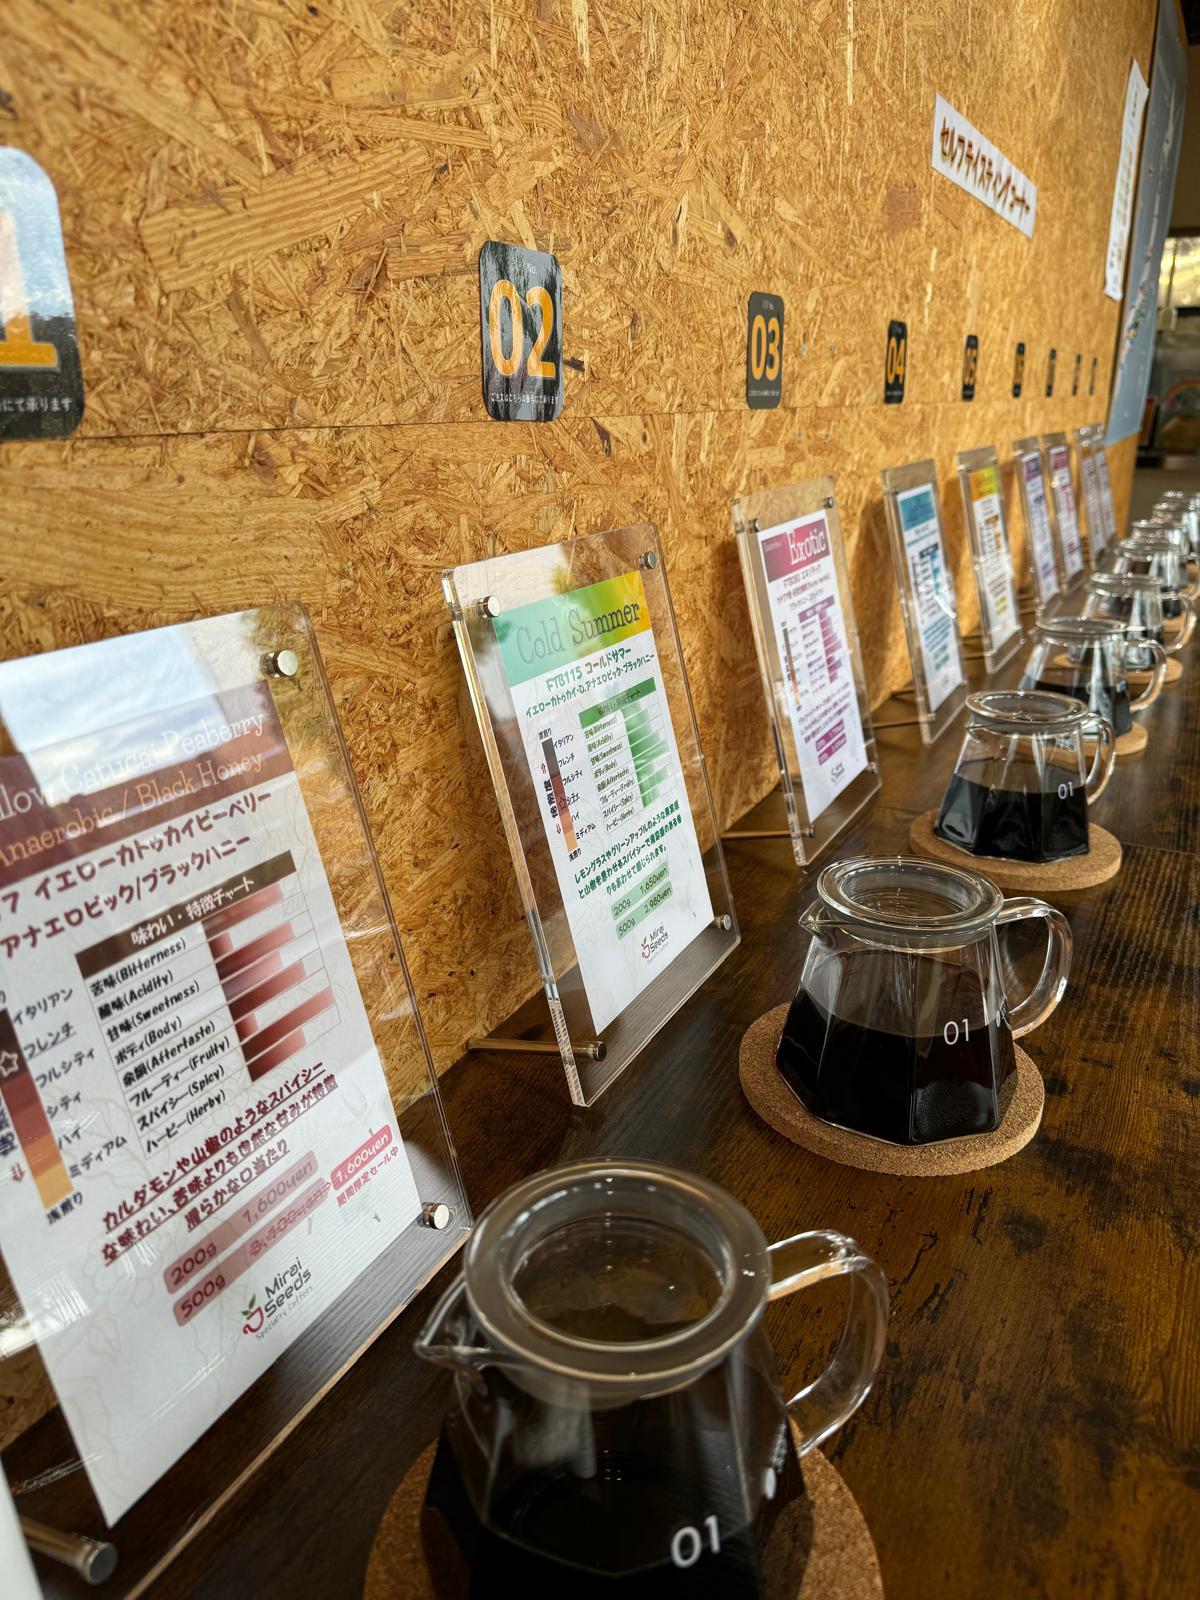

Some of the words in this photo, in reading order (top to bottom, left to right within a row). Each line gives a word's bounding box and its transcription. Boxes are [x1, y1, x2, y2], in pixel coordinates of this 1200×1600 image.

[488, 278, 556, 378] 02
[751, 314, 780, 381] 03
[886, 336, 906, 384] 04
[787, 528, 827, 565] Exotic
[516, 617, 565, 665] Cold
[567, 601, 640, 646] Summer
[584, 647, 632, 675] コールドサマー
[160, 713, 265, 756] Peaberry
[135, 768, 197, 811] Black
[196, 752, 263, 787] Honey
[1057, 781, 1074, 800] 01
[34, 791, 272, 900] イエローカトゥカイビーベリー
[0, 836, 250, 958] アナエロビック/ブラックハニー
[130, 875, 255, 945] 味わい・特徴チャート
[613, 898, 631, 917] 200g
[618, 918, 636, 937] 500g
[13, 988, 74, 1026] イタリアン
[106, 981, 200, 1042] 甘味(Sweetness)
[24, 1022, 75, 1058] フレンチ
[943, 1018, 969, 1046] 01
[36, 1048, 95, 1090] フルシティ
[129, 1036, 230, 1107] フルーティー(Fruity)
[47, 1091, 83, 1120] シティ
[137, 1064, 225, 1131] スパイシー(Spicy)
[145, 1089, 226, 1153] ハービー(Herby)
[58, 1126, 82, 1150] ハイ
[69, 1136, 128, 1178] ミディアム
[171, 1242, 217, 1287] 200g
[242, 1161, 313, 1223] 1,600yen
[181, 1274, 226, 1318] 500g
[335, 1133, 389, 1182] 1,600yen
[264, 1269, 312, 1319] Seeds
[265, 1256, 303, 1299] Mirai
[670, 1514, 721, 1569] 01
